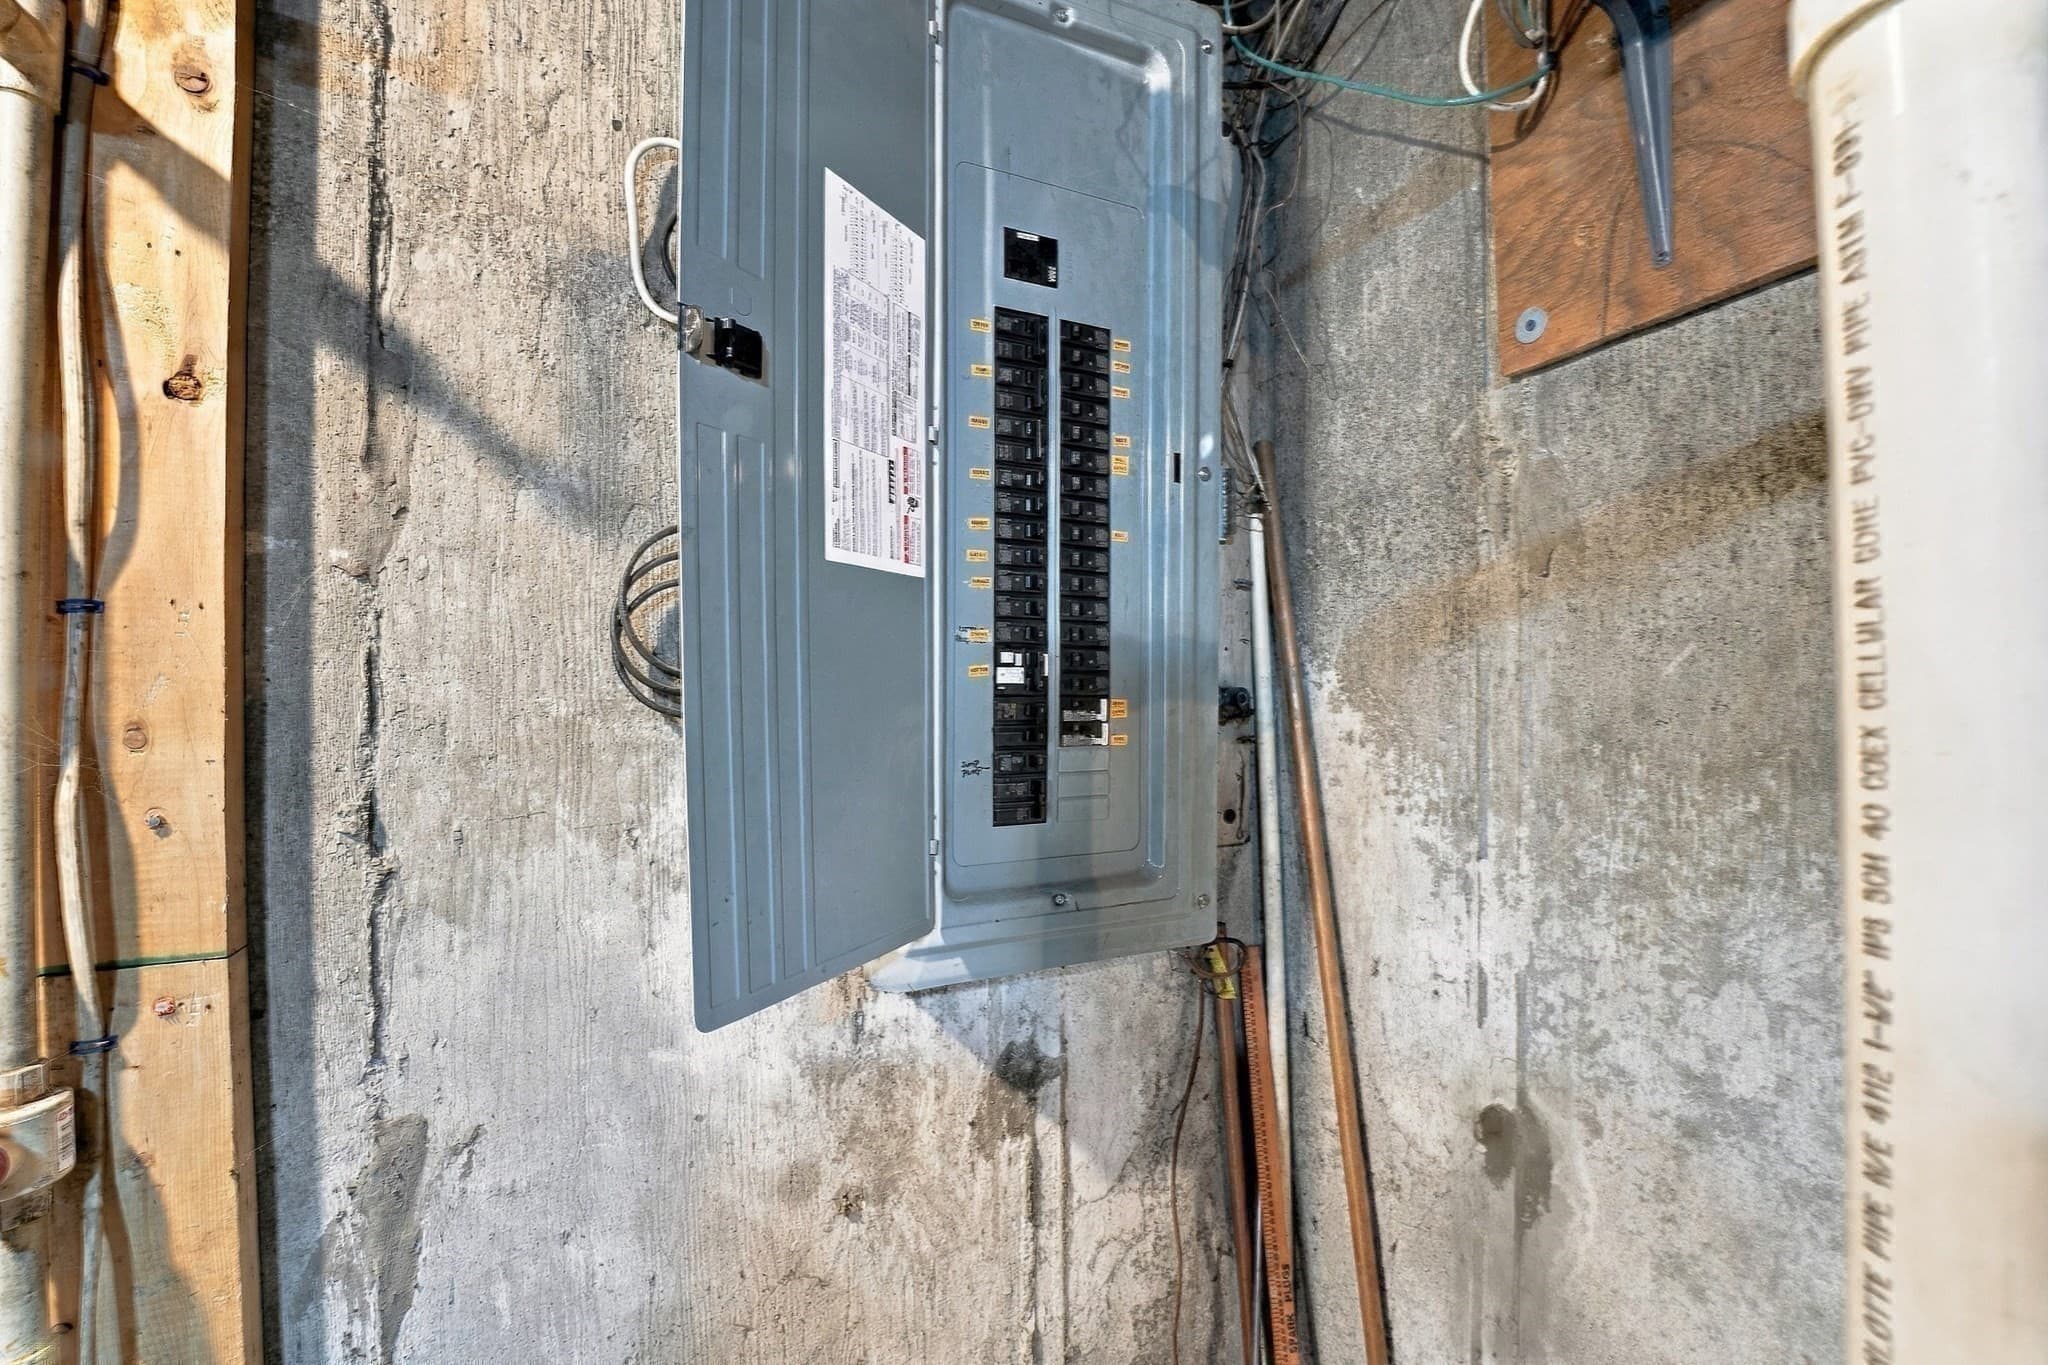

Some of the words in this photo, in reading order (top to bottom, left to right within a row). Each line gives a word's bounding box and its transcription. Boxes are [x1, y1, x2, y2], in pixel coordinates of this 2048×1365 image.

[1836, 208, 1867, 286] ASTM
[1841, 291, 1871, 357] PIPE
[1852, 496, 1881, 564] CORE
[1854, 576, 1888, 711] CELLULAR
[1860, 803, 1891, 841] 40
[1861, 852, 1891, 904] SCH
[1282, 1264, 1292, 1302] PLUGS
[1286, 1313, 1298, 1354] SPARK
